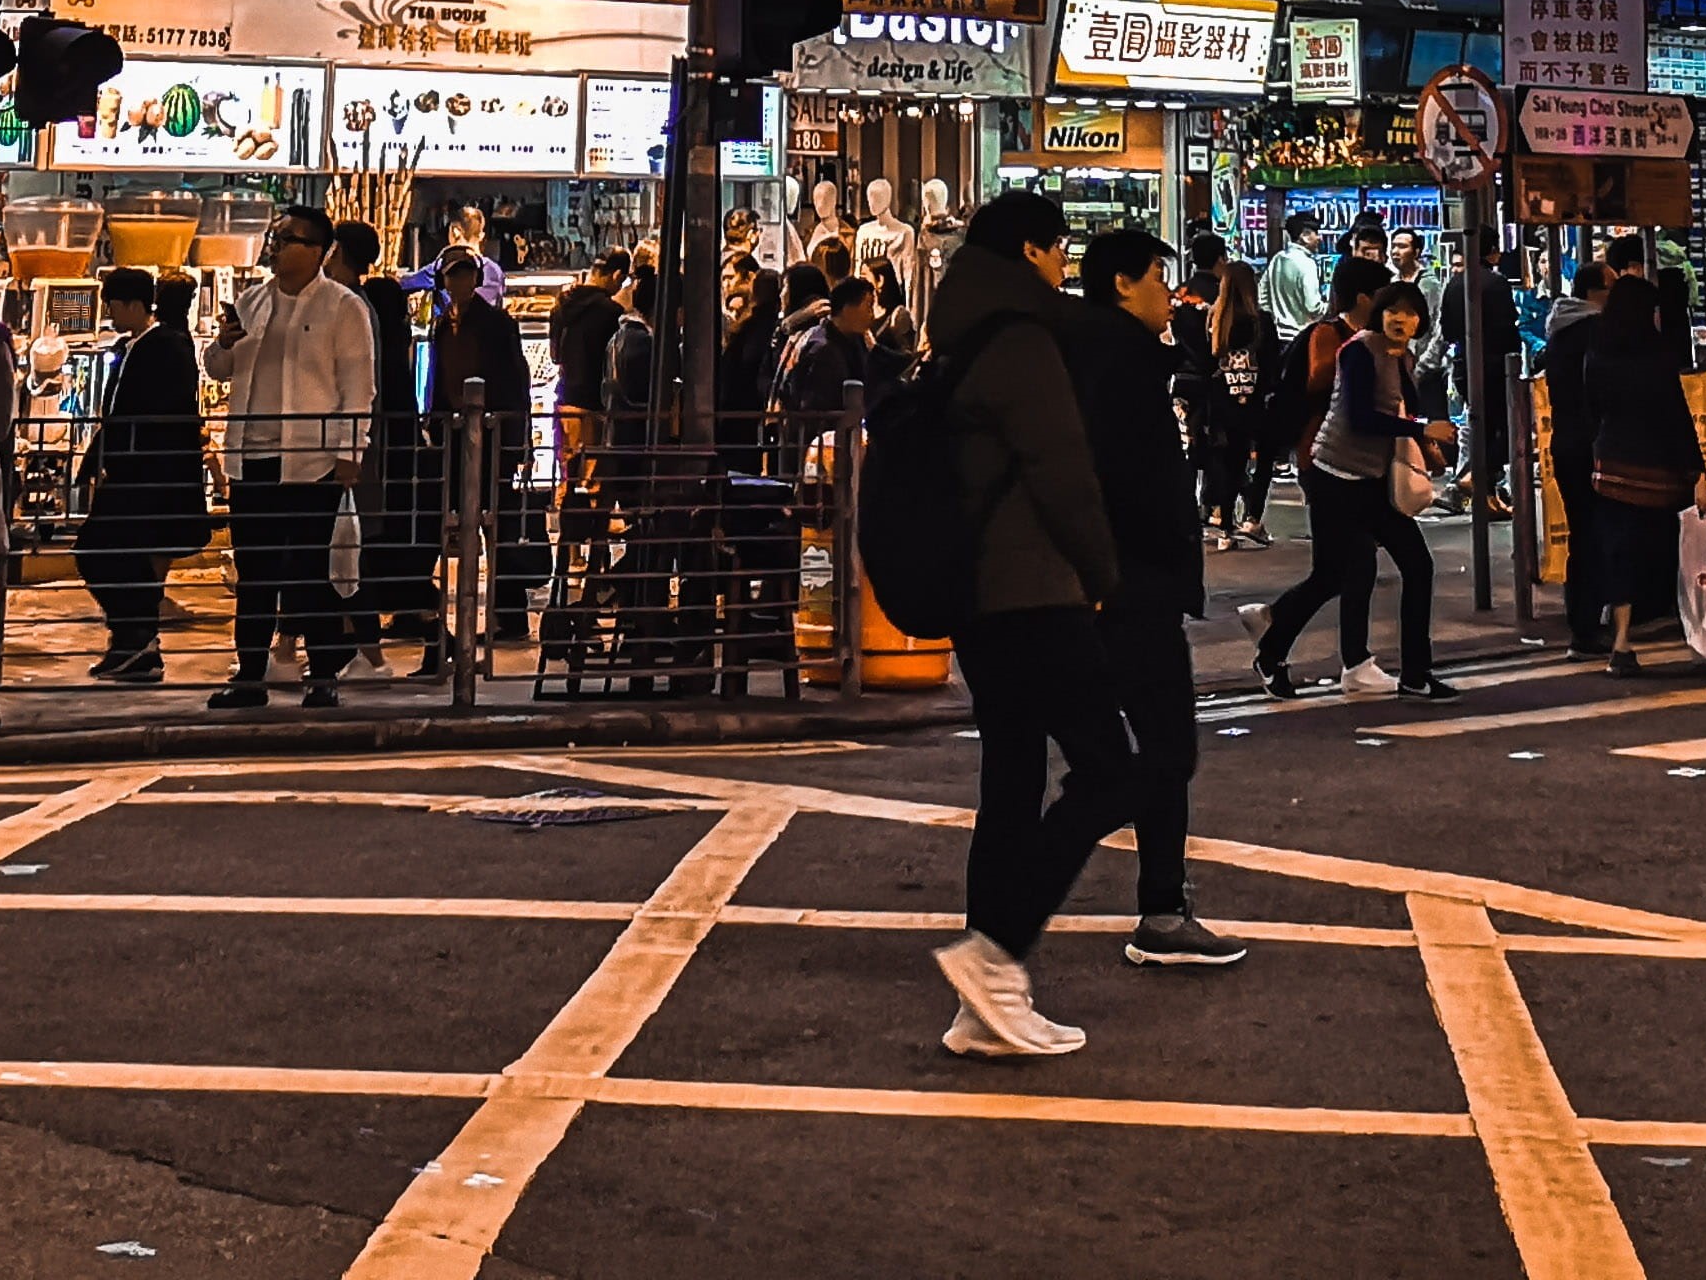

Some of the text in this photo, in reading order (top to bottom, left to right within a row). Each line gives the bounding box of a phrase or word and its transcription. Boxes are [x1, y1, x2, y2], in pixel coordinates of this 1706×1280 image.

[408, 6, 487, 23] TEA HOUSE
[1530, 0, 1619, 22] 停車等候
[1084, 11, 1251, 62] 壹圓攝影器材
[1531, 31, 1619, 54] 會被檢控
[867, 57, 973, 83] design & life
[1519, 61, 1631, 85] 而不予警告
[789, 97, 836, 123] SALE
[1533, 96, 1552, 112] Sai
[1554, 98, 1587, 117] Yeung
[1590, 98, 1615, 116] Choi
[1617, 101, 1649, 118] Street
[1048, 126, 1120, 148] Nikon
